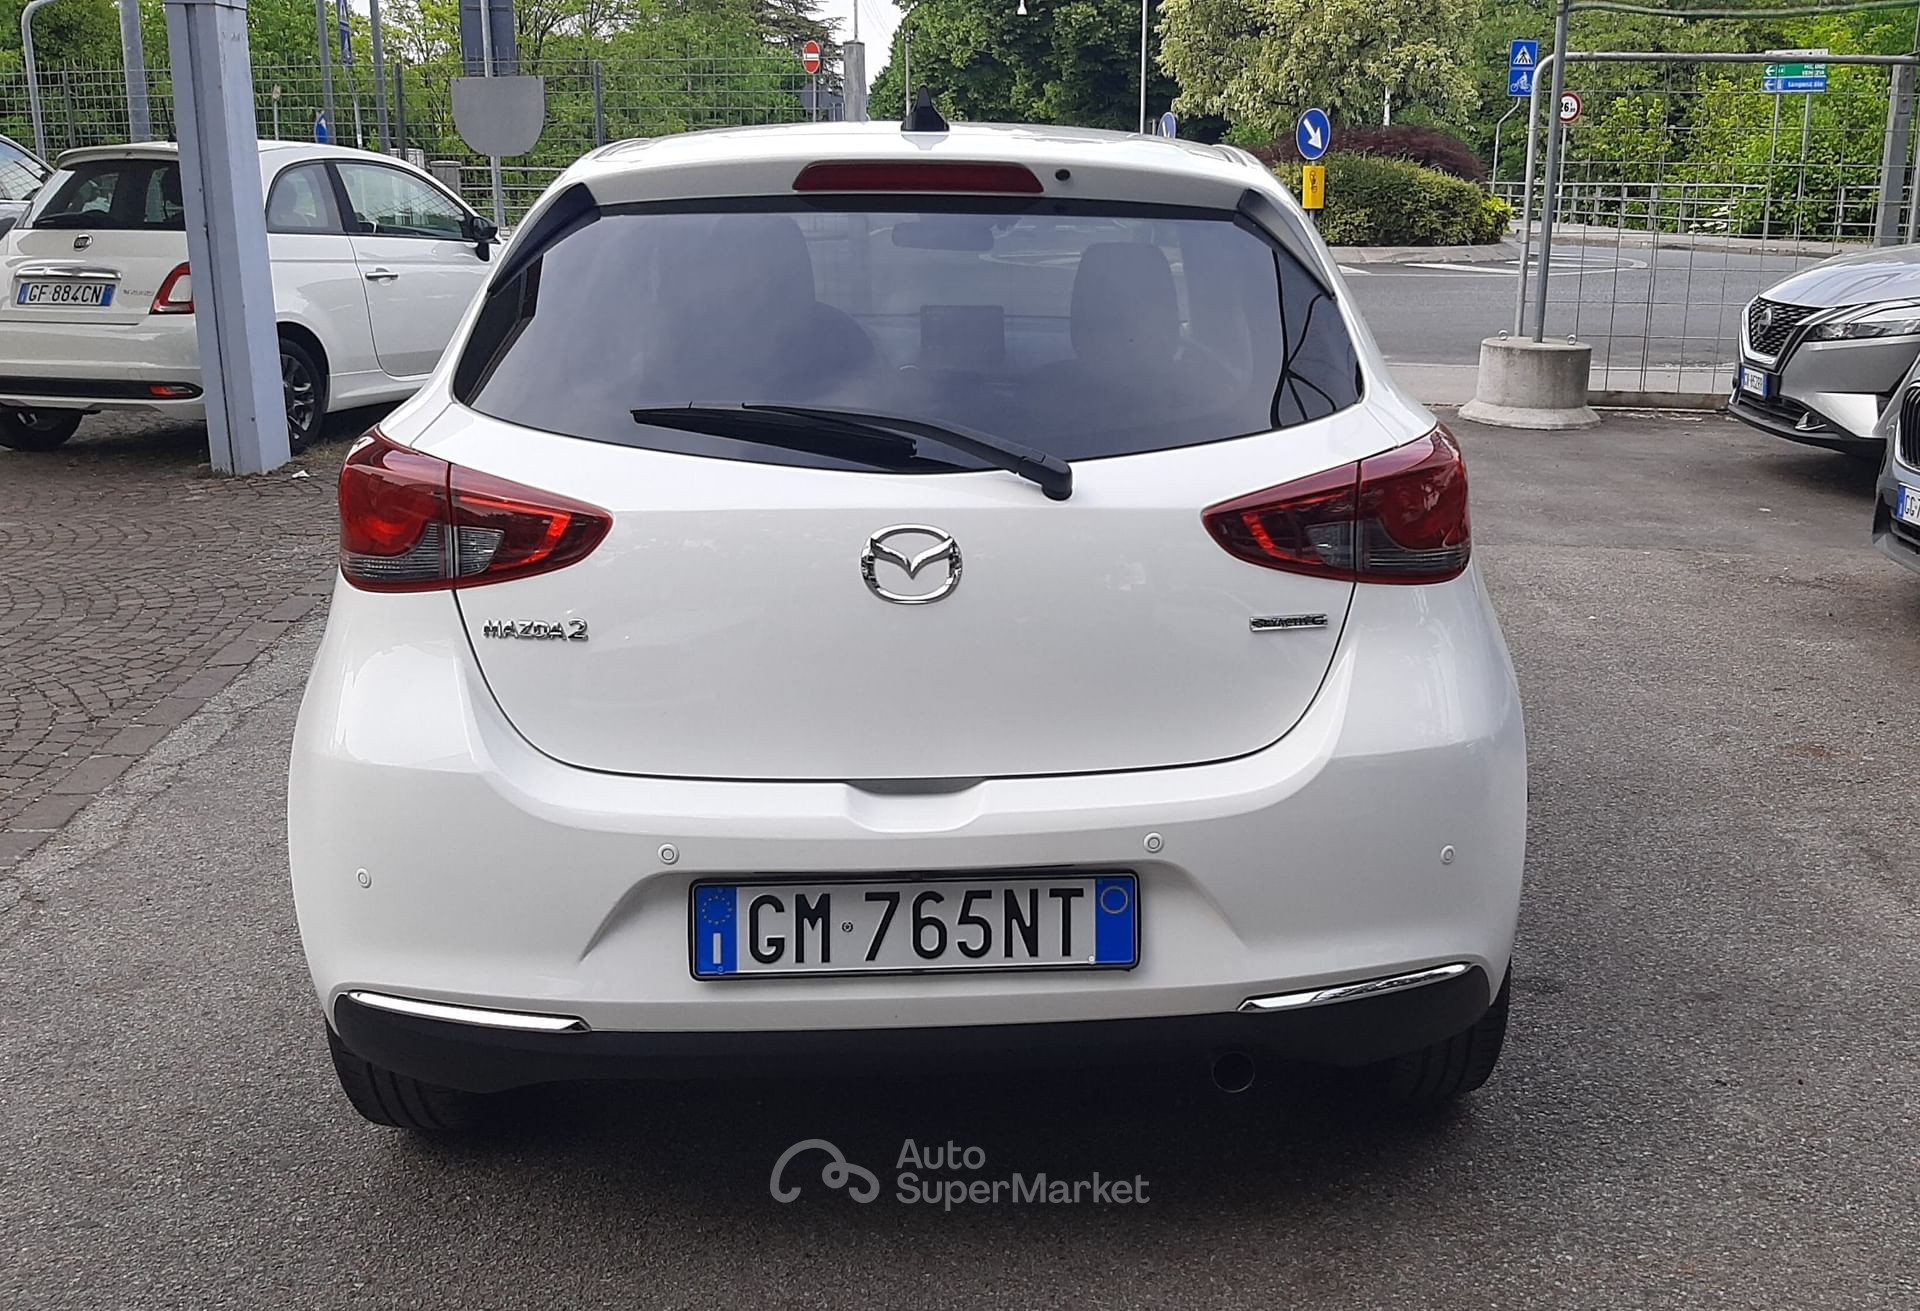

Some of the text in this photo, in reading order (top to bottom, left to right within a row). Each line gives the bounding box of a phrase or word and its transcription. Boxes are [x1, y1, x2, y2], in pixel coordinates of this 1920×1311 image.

[482, 619, 567, 641] MAZDA
[747, 892, 831, 965] GM
[863, 886, 1085, 962] 765NT
